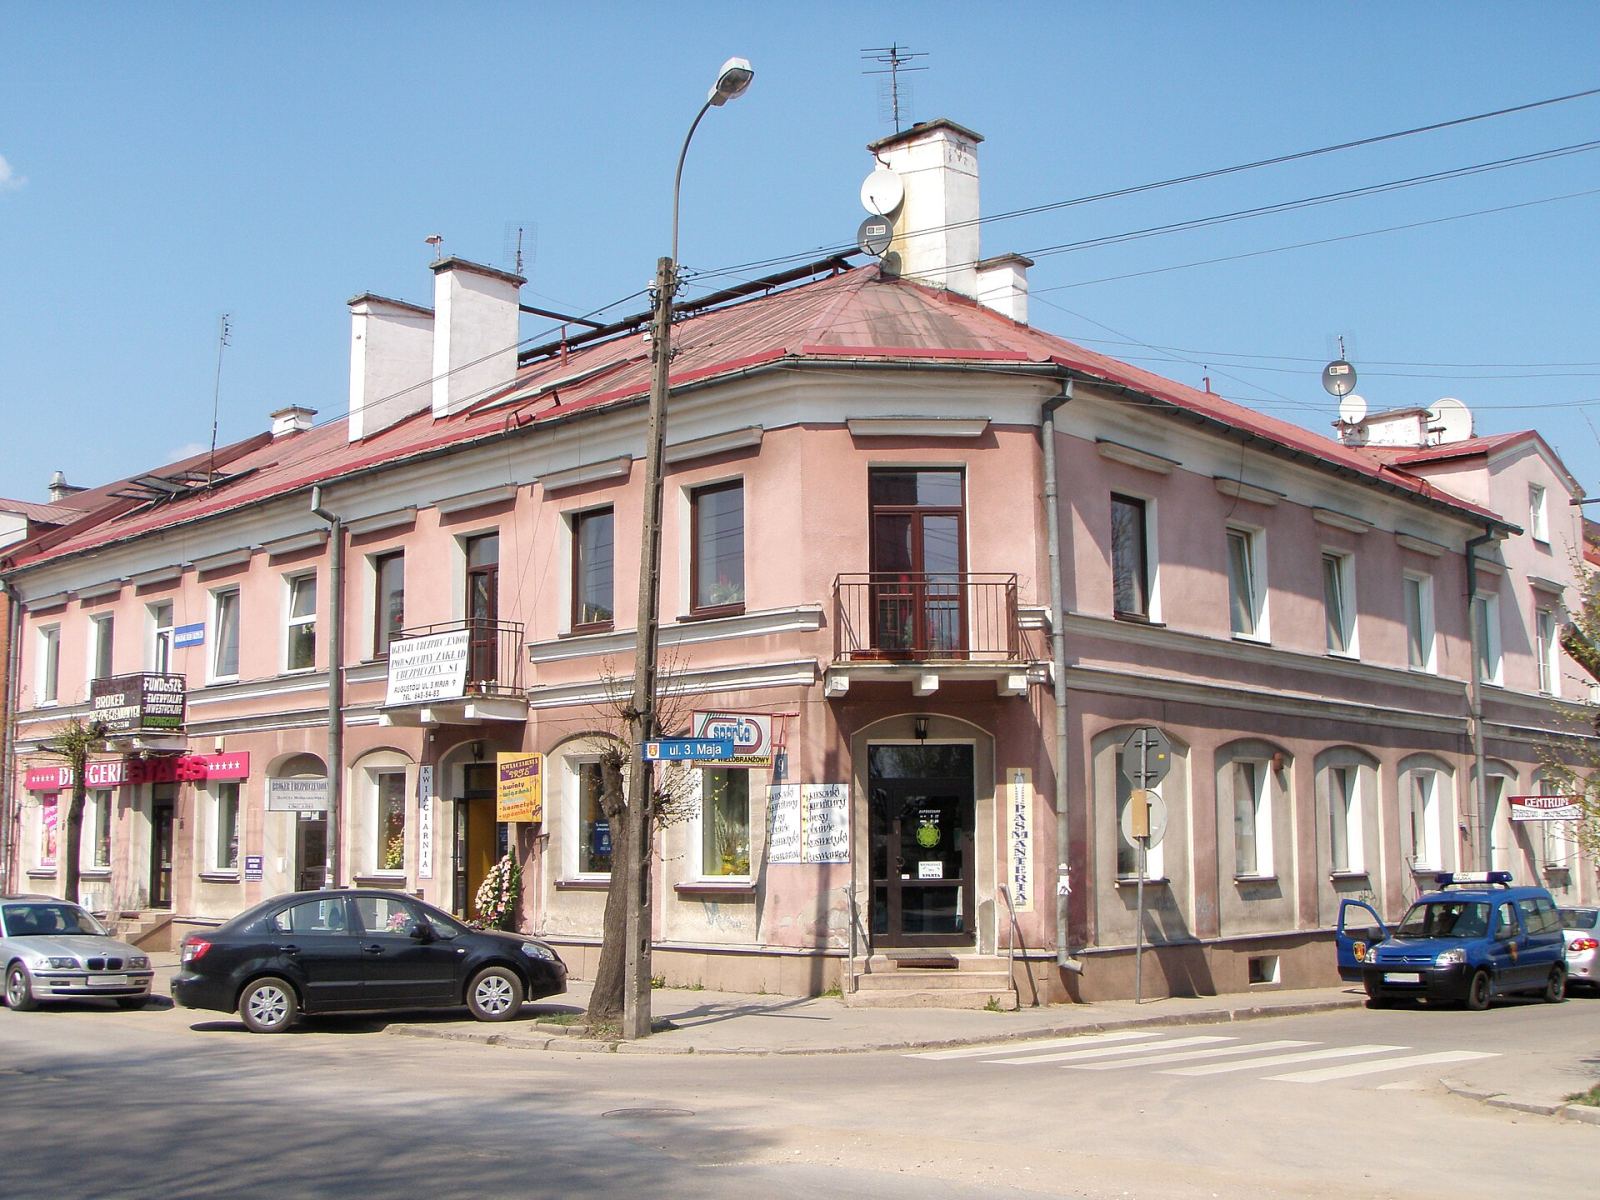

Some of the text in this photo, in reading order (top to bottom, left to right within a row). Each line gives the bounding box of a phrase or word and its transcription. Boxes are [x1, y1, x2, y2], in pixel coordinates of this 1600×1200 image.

[95, 693, 125, 709] BROKER
[669, 745, 681, 756] ul.
[684, 744, 694, 756] 3.
[697, 744, 722, 757] Maja
[1524, 797, 1569, 808] CENTRUM
[422, 767, 431, 867] KWIACIARNIA
